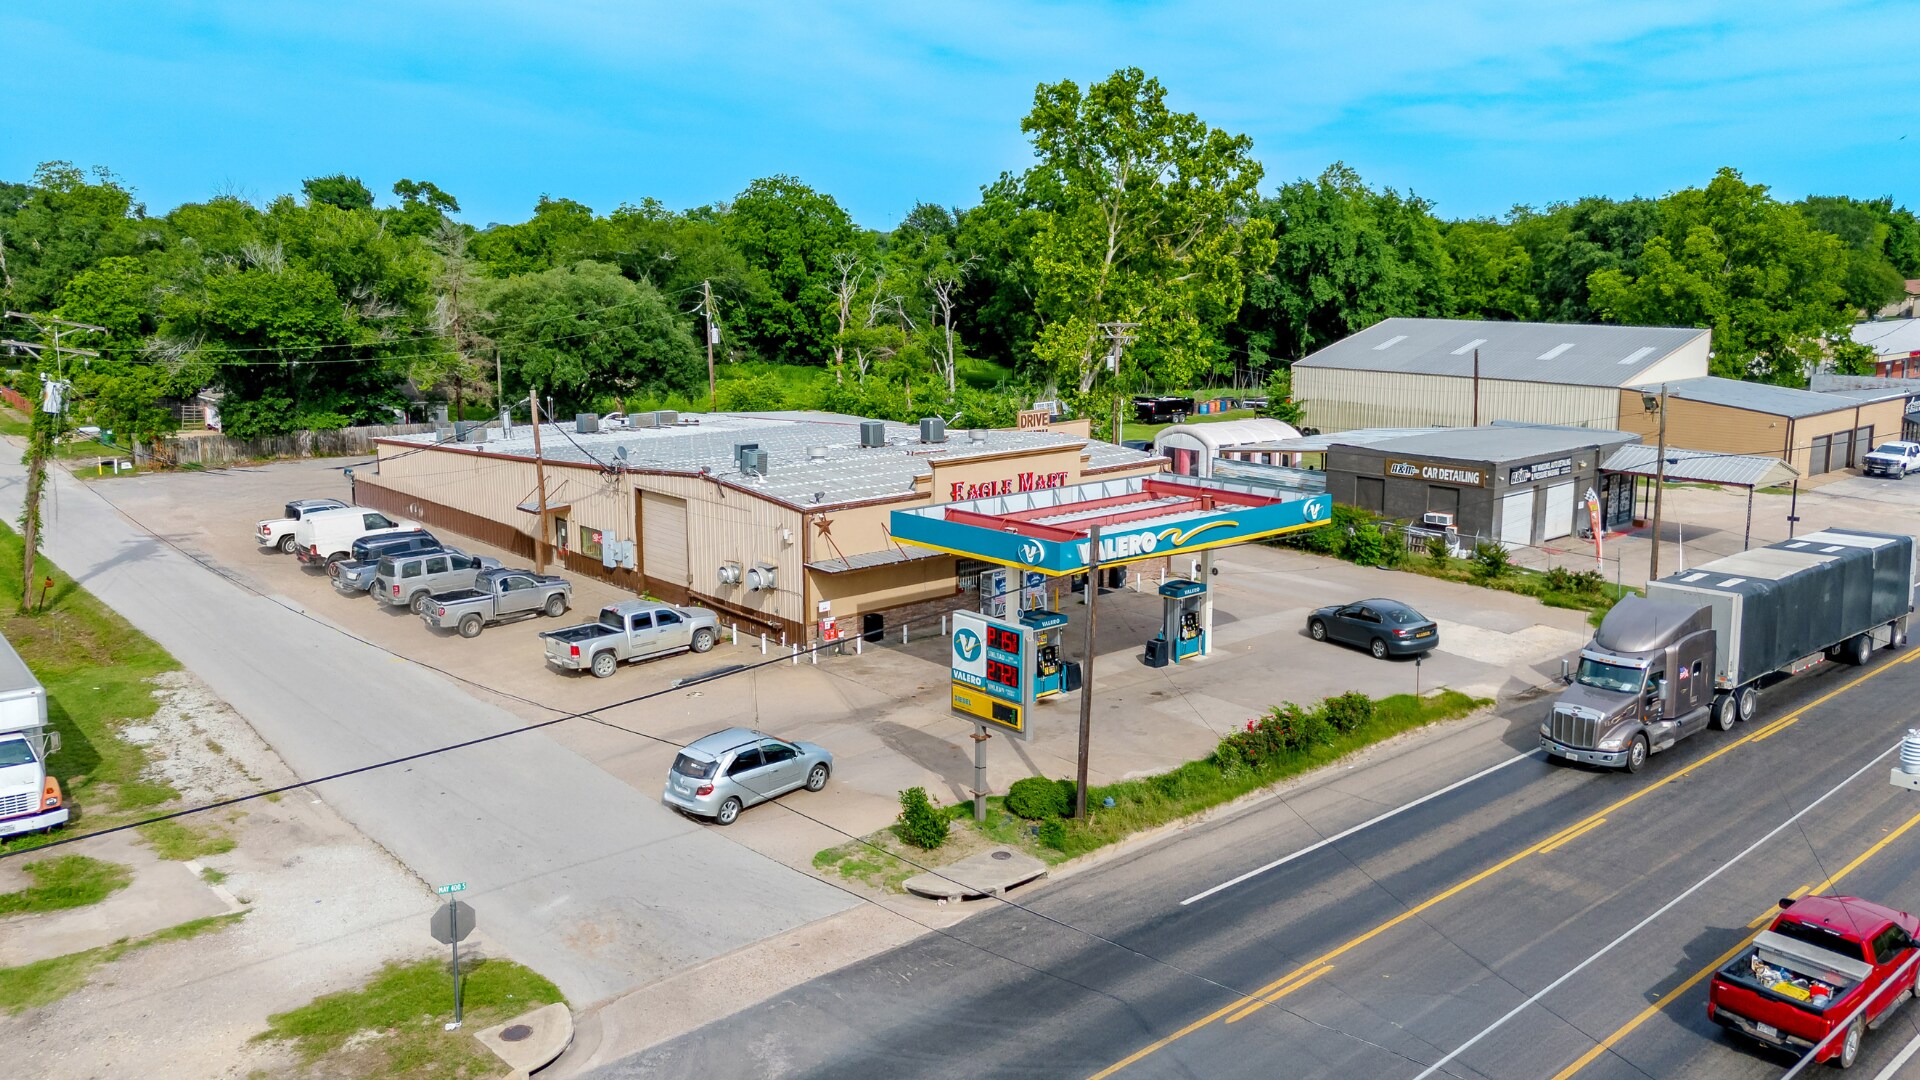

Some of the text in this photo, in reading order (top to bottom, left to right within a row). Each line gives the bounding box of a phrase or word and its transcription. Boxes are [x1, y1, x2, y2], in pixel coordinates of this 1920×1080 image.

[1020, 412, 1049, 429] DRIVE
[1422, 466, 1438, 479] CAR
[1438, 468, 1480, 484] DETAILING
[950, 471, 1068, 502] EAGLE MART
[1076, 531, 1157, 564] VALERO
[1184, 587, 1200, 595] VALERO
[1041, 618, 1060, 627] VALERO
[953, 669, 982, 686] VALERO
